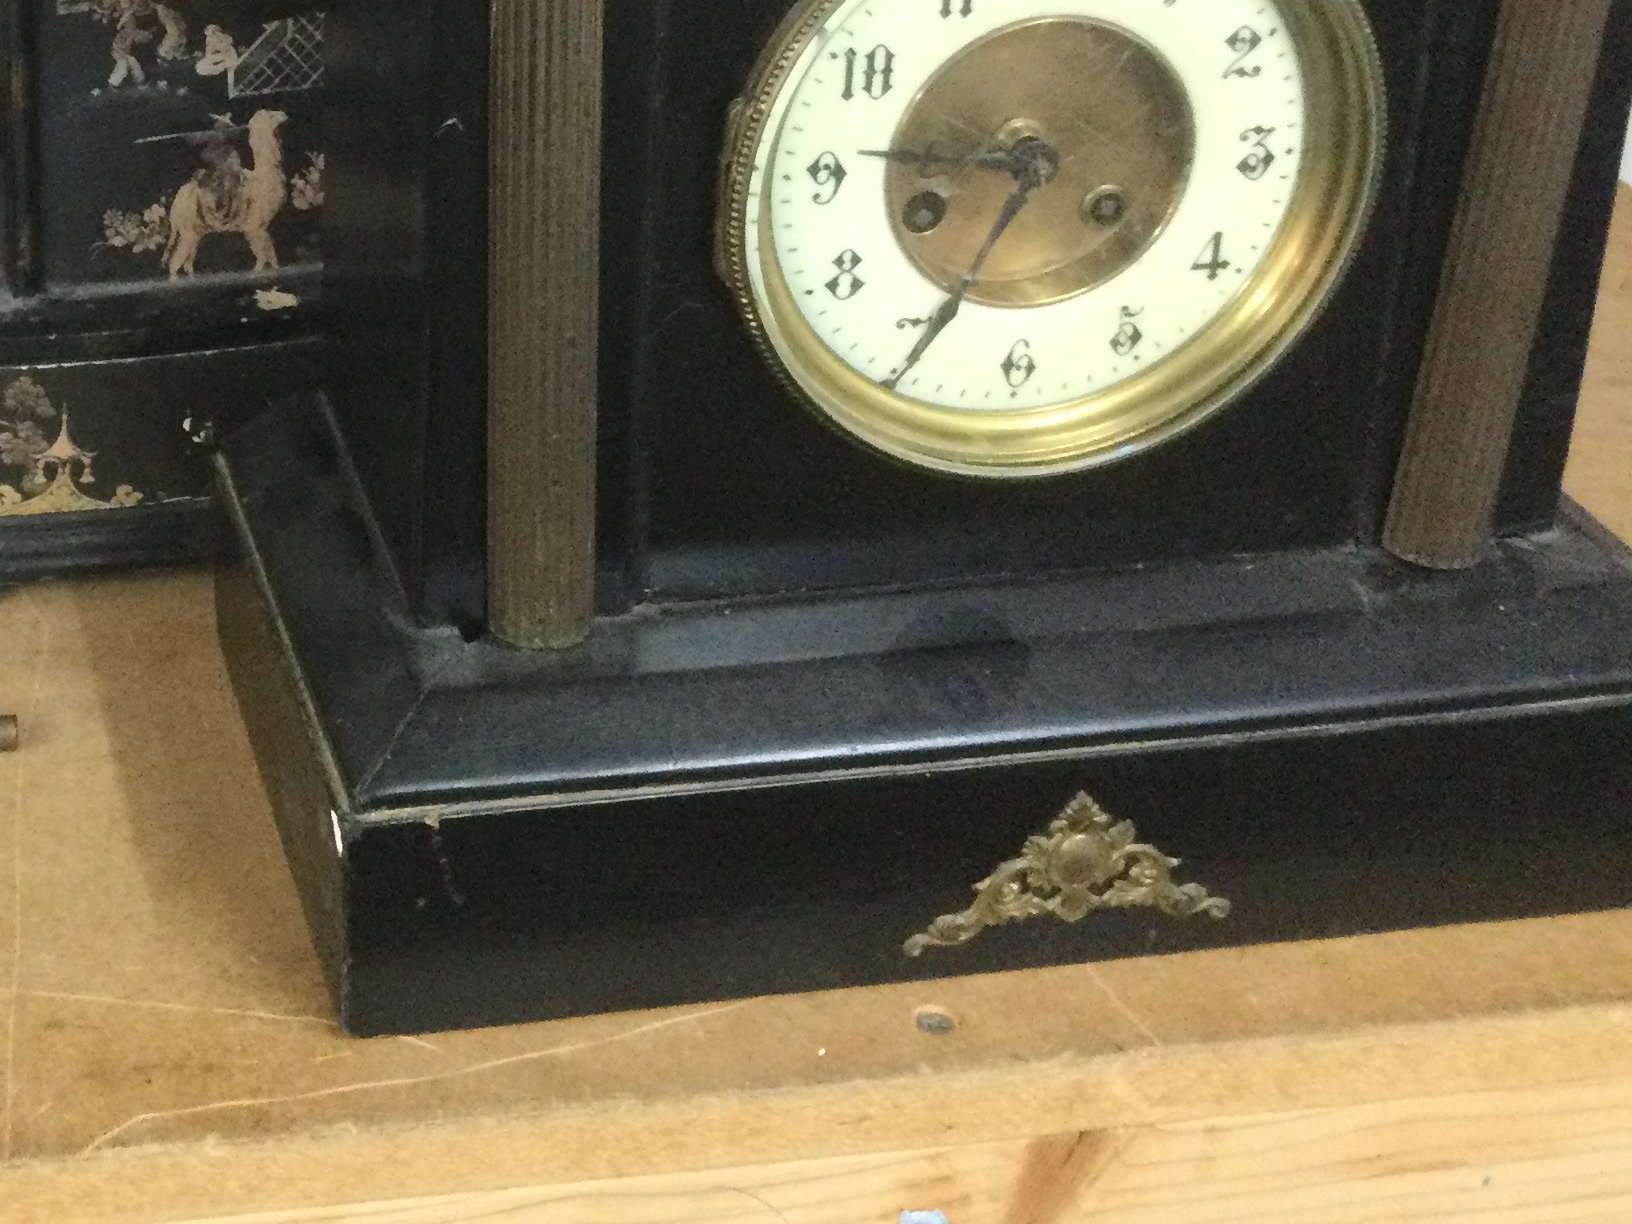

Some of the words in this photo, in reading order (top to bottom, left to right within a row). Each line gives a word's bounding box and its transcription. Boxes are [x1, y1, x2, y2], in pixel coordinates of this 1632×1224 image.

[841, 43, 895, 101] 10
[1222, 25, 1263, 79] 2
[805, 150, 848, 205] 9
[1235, 125, 1275, 180] 3
[824, 248, 866, 301] 8
[1188, 230, 1232, 281] 4
[1108, 305, 1145, 356] 5
[1000, 338, 1037, 389] 6
